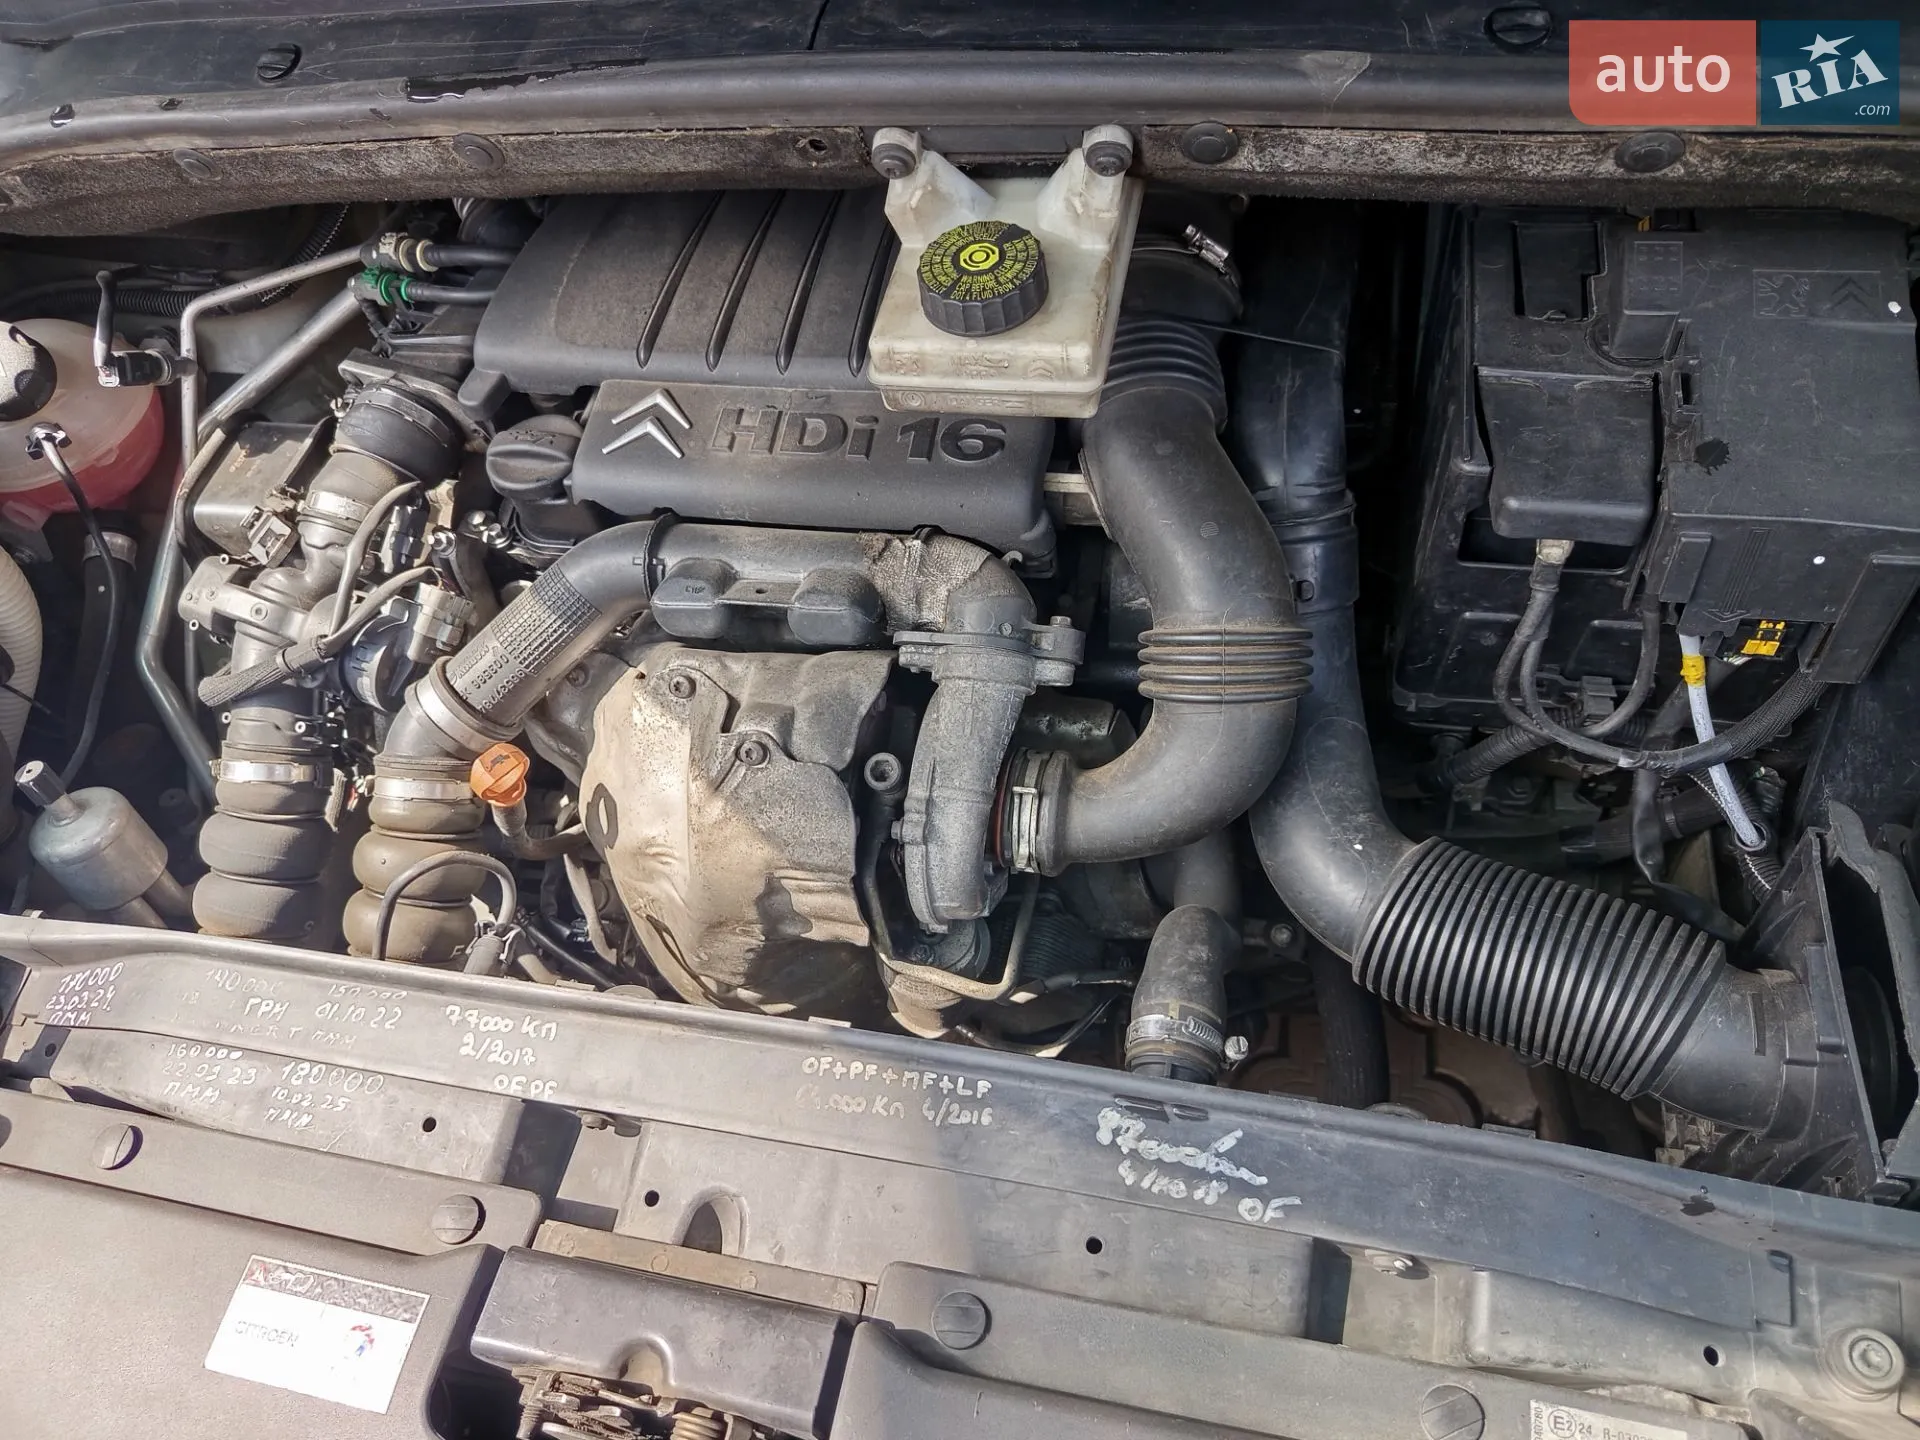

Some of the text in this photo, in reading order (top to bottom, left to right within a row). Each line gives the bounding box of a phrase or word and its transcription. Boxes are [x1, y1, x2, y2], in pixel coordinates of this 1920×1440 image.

[961, 273, 994, 283] WARNING
[994, 260, 1011, 276] CLEAN
[950, 291, 964, 299] DOT
[972, 290, 994, 301] FLUID
[956, 284, 970, 292] CAP
[971, 282, 999, 292] BEFORE
[712, 407, 1007, 464] HDi 16
[445, 1004, 515, 1034] 77000
[458, 1032, 538, 1067] 2/2017
[1578, 1422, 1592, 1436] 24
